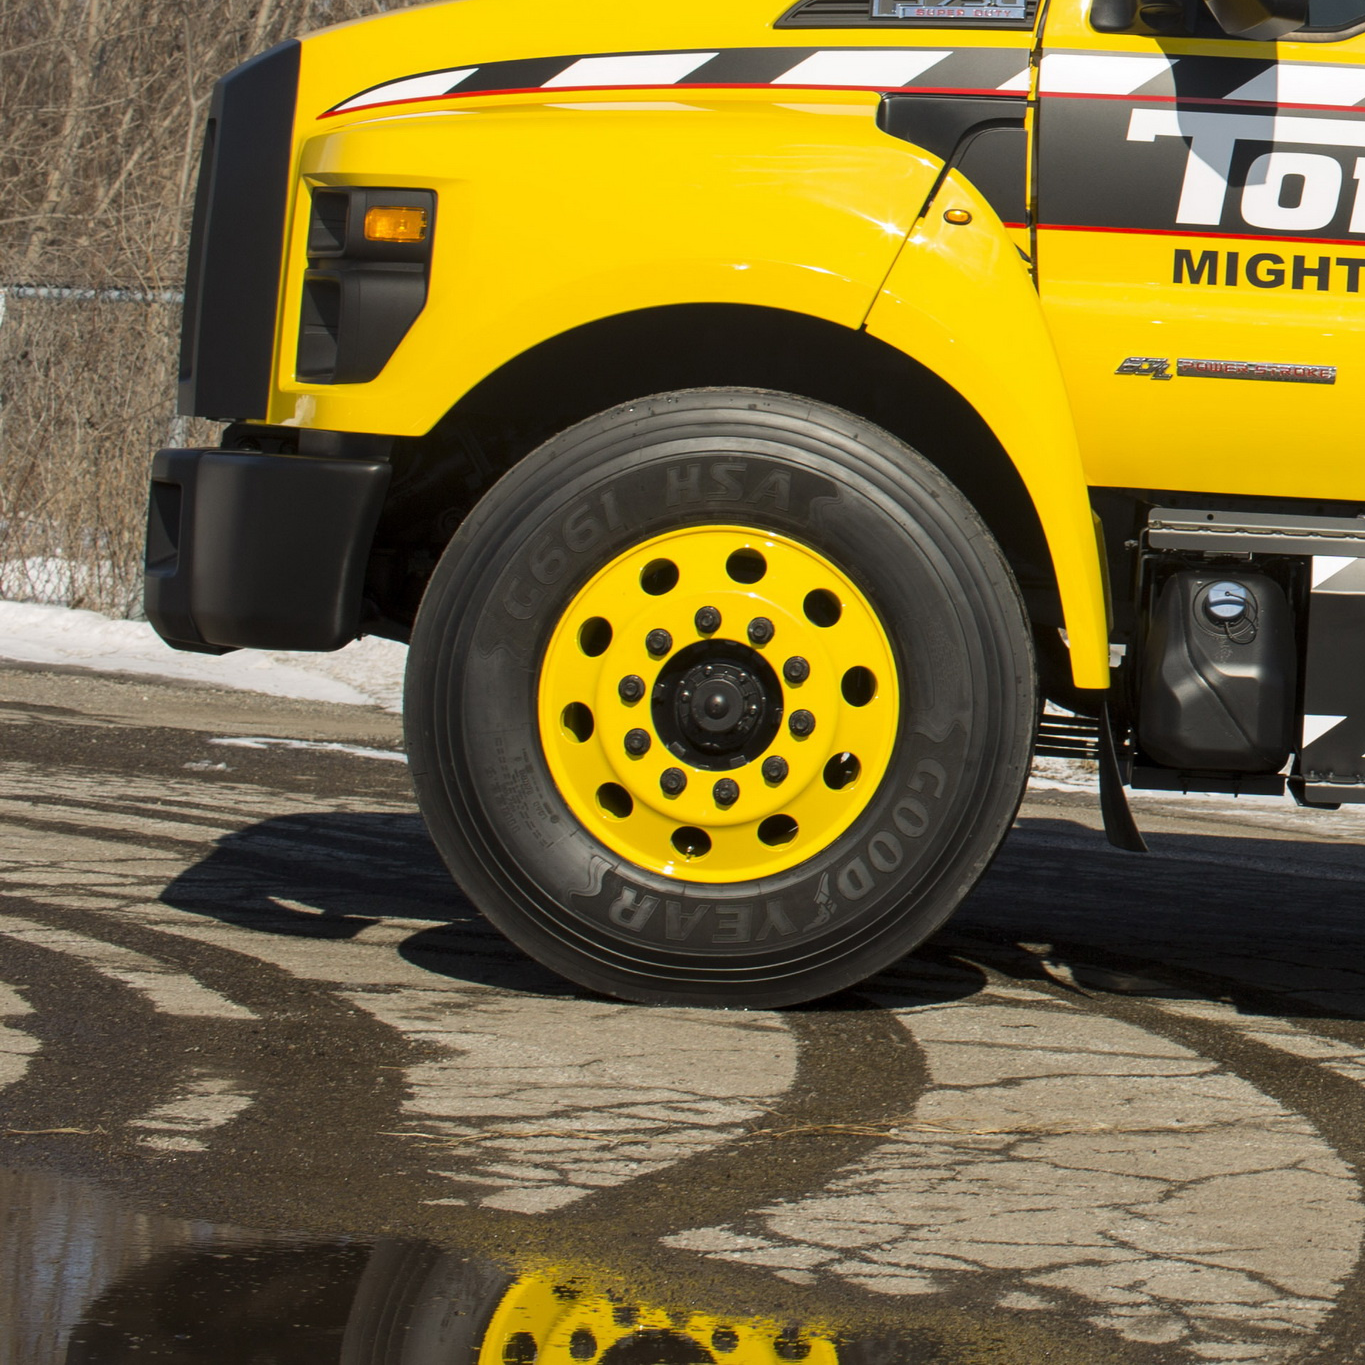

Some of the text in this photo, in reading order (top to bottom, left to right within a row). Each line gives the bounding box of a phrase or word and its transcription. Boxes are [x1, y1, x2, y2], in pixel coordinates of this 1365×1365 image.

[915, 8, 1012, 17] SUPER DUTY
[1182, 361, 1249, 375] POWER
[1254, 365, 1331, 379] STROKE
[665, 461, 793, 512] HSA
